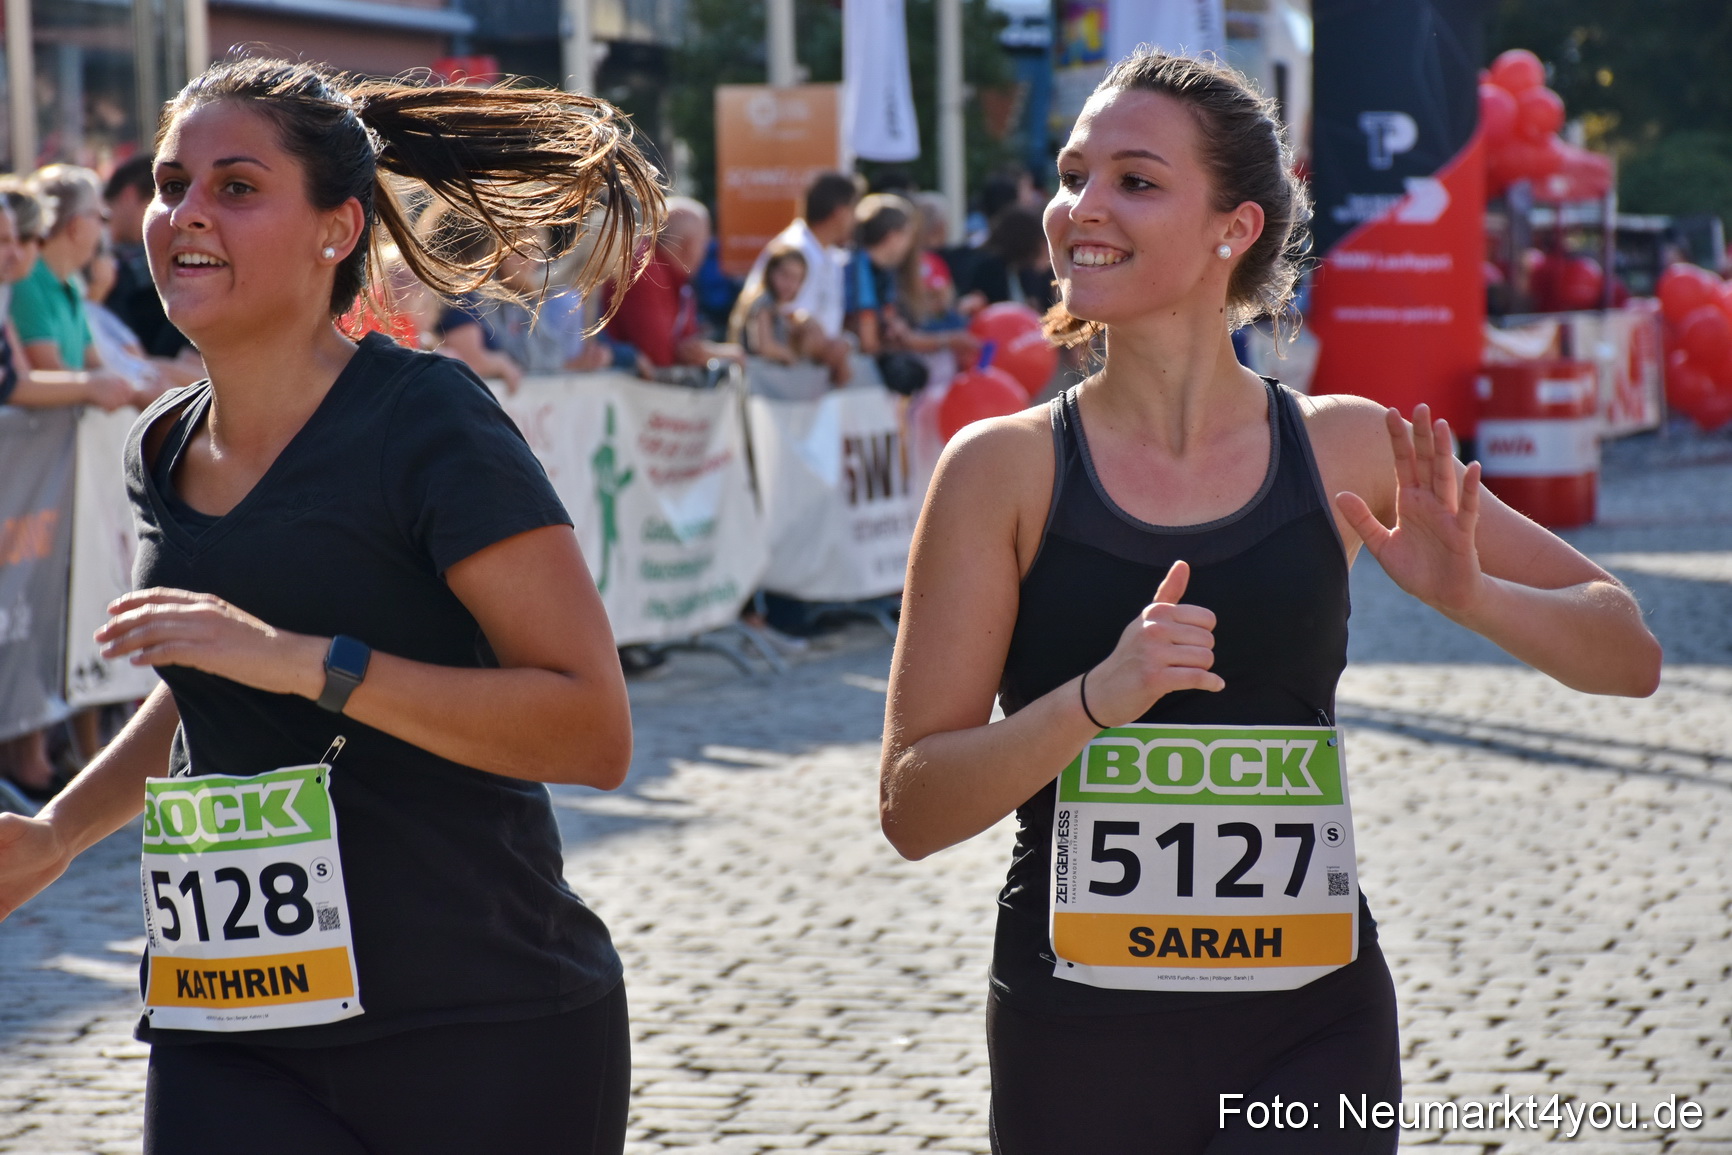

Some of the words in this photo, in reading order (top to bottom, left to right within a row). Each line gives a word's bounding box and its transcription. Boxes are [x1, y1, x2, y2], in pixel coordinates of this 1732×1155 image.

[1079, 737, 1324, 796] BOCK
[1326, 827, 1339, 842] S
[316, 863, 328, 877] S
[1089, 821, 1316, 898] 5127
[151, 862, 314, 942] 5128
[1128, 926, 1282, 959] SARAH
[176, 963, 309, 1000] KATHRIN
